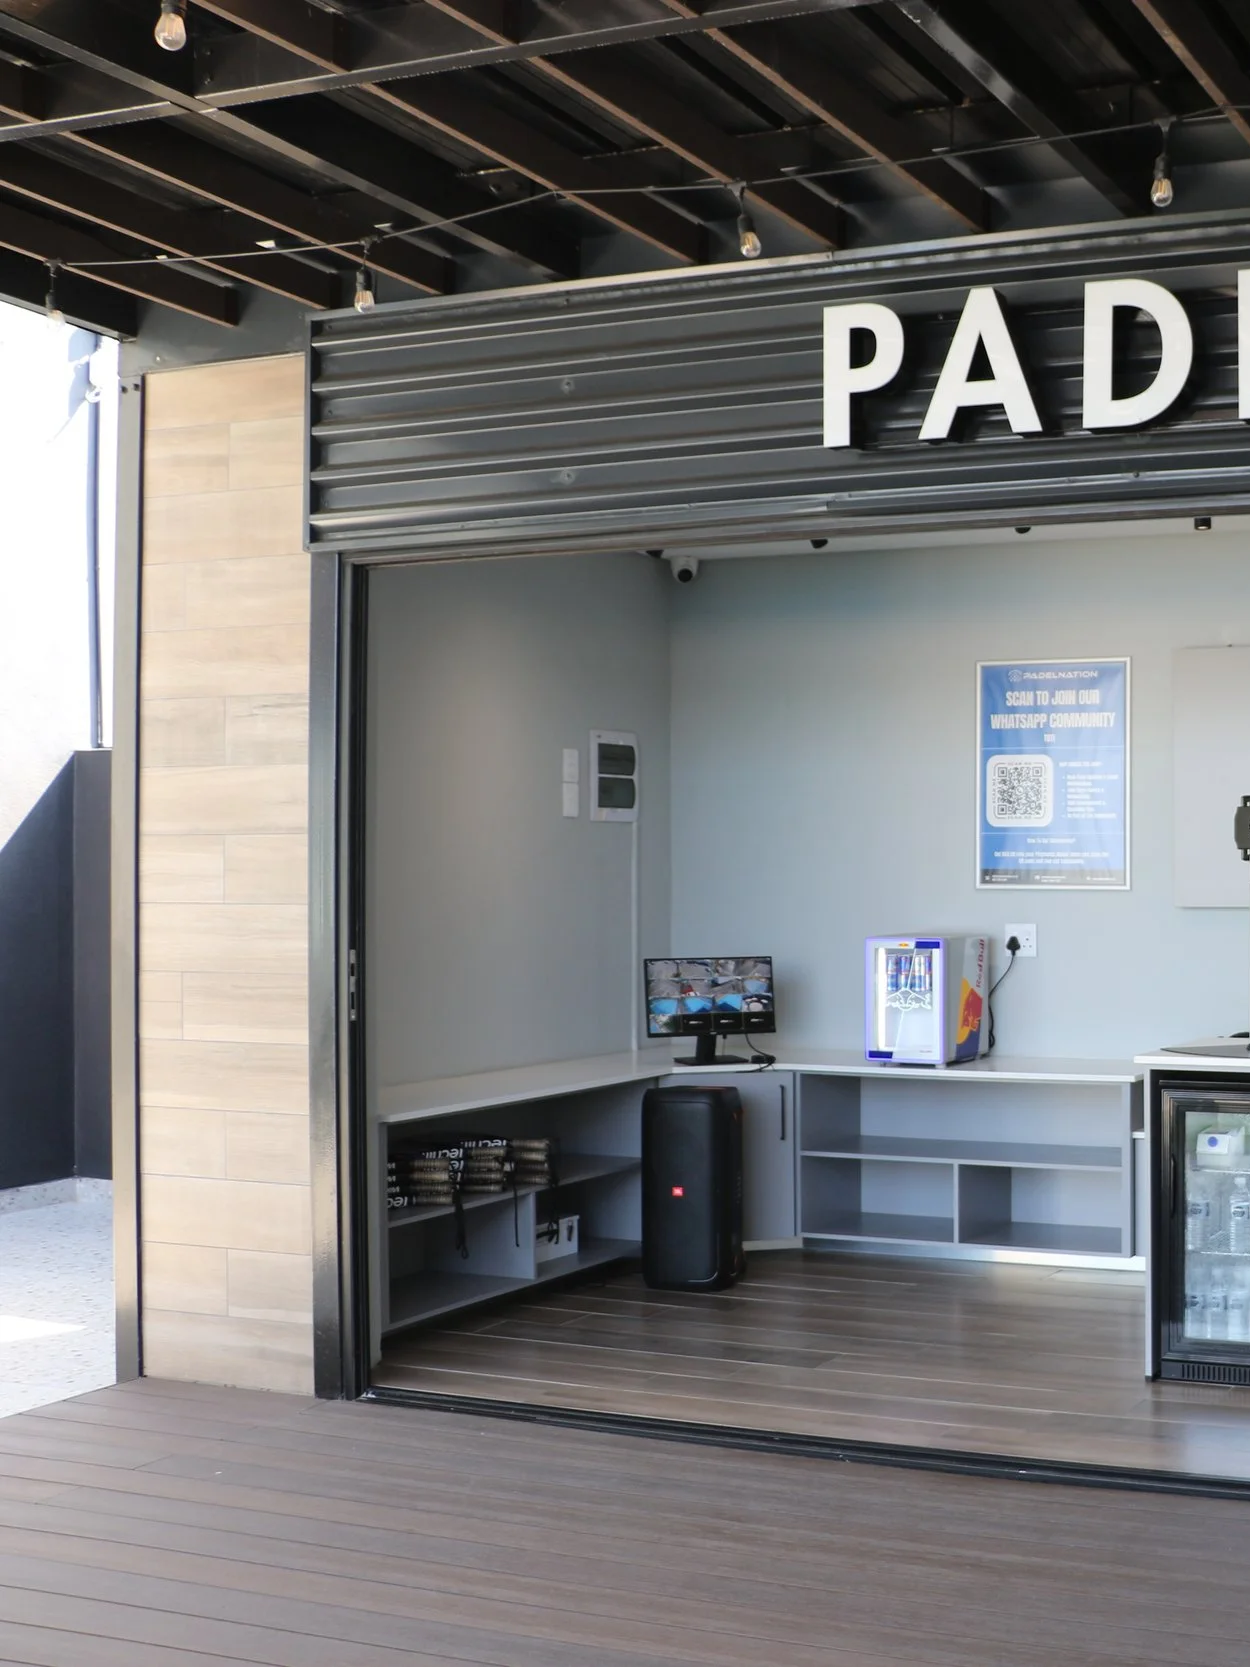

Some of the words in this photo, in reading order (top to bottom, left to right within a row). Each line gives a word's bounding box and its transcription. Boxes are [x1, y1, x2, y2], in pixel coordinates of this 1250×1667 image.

[1023, 670, 1098, 680] PADELNATION
[1005, 690, 1034, 707] SCAN
[1036, 690, 1048, 706] TO
[1051, 689, 1076, 706] JOIN
[1078, 688, 1100, 705] OUR
[990, 713, 1047, 729] WHATSAPP
[1049, 711, 1116, 728] COMMUNITY
